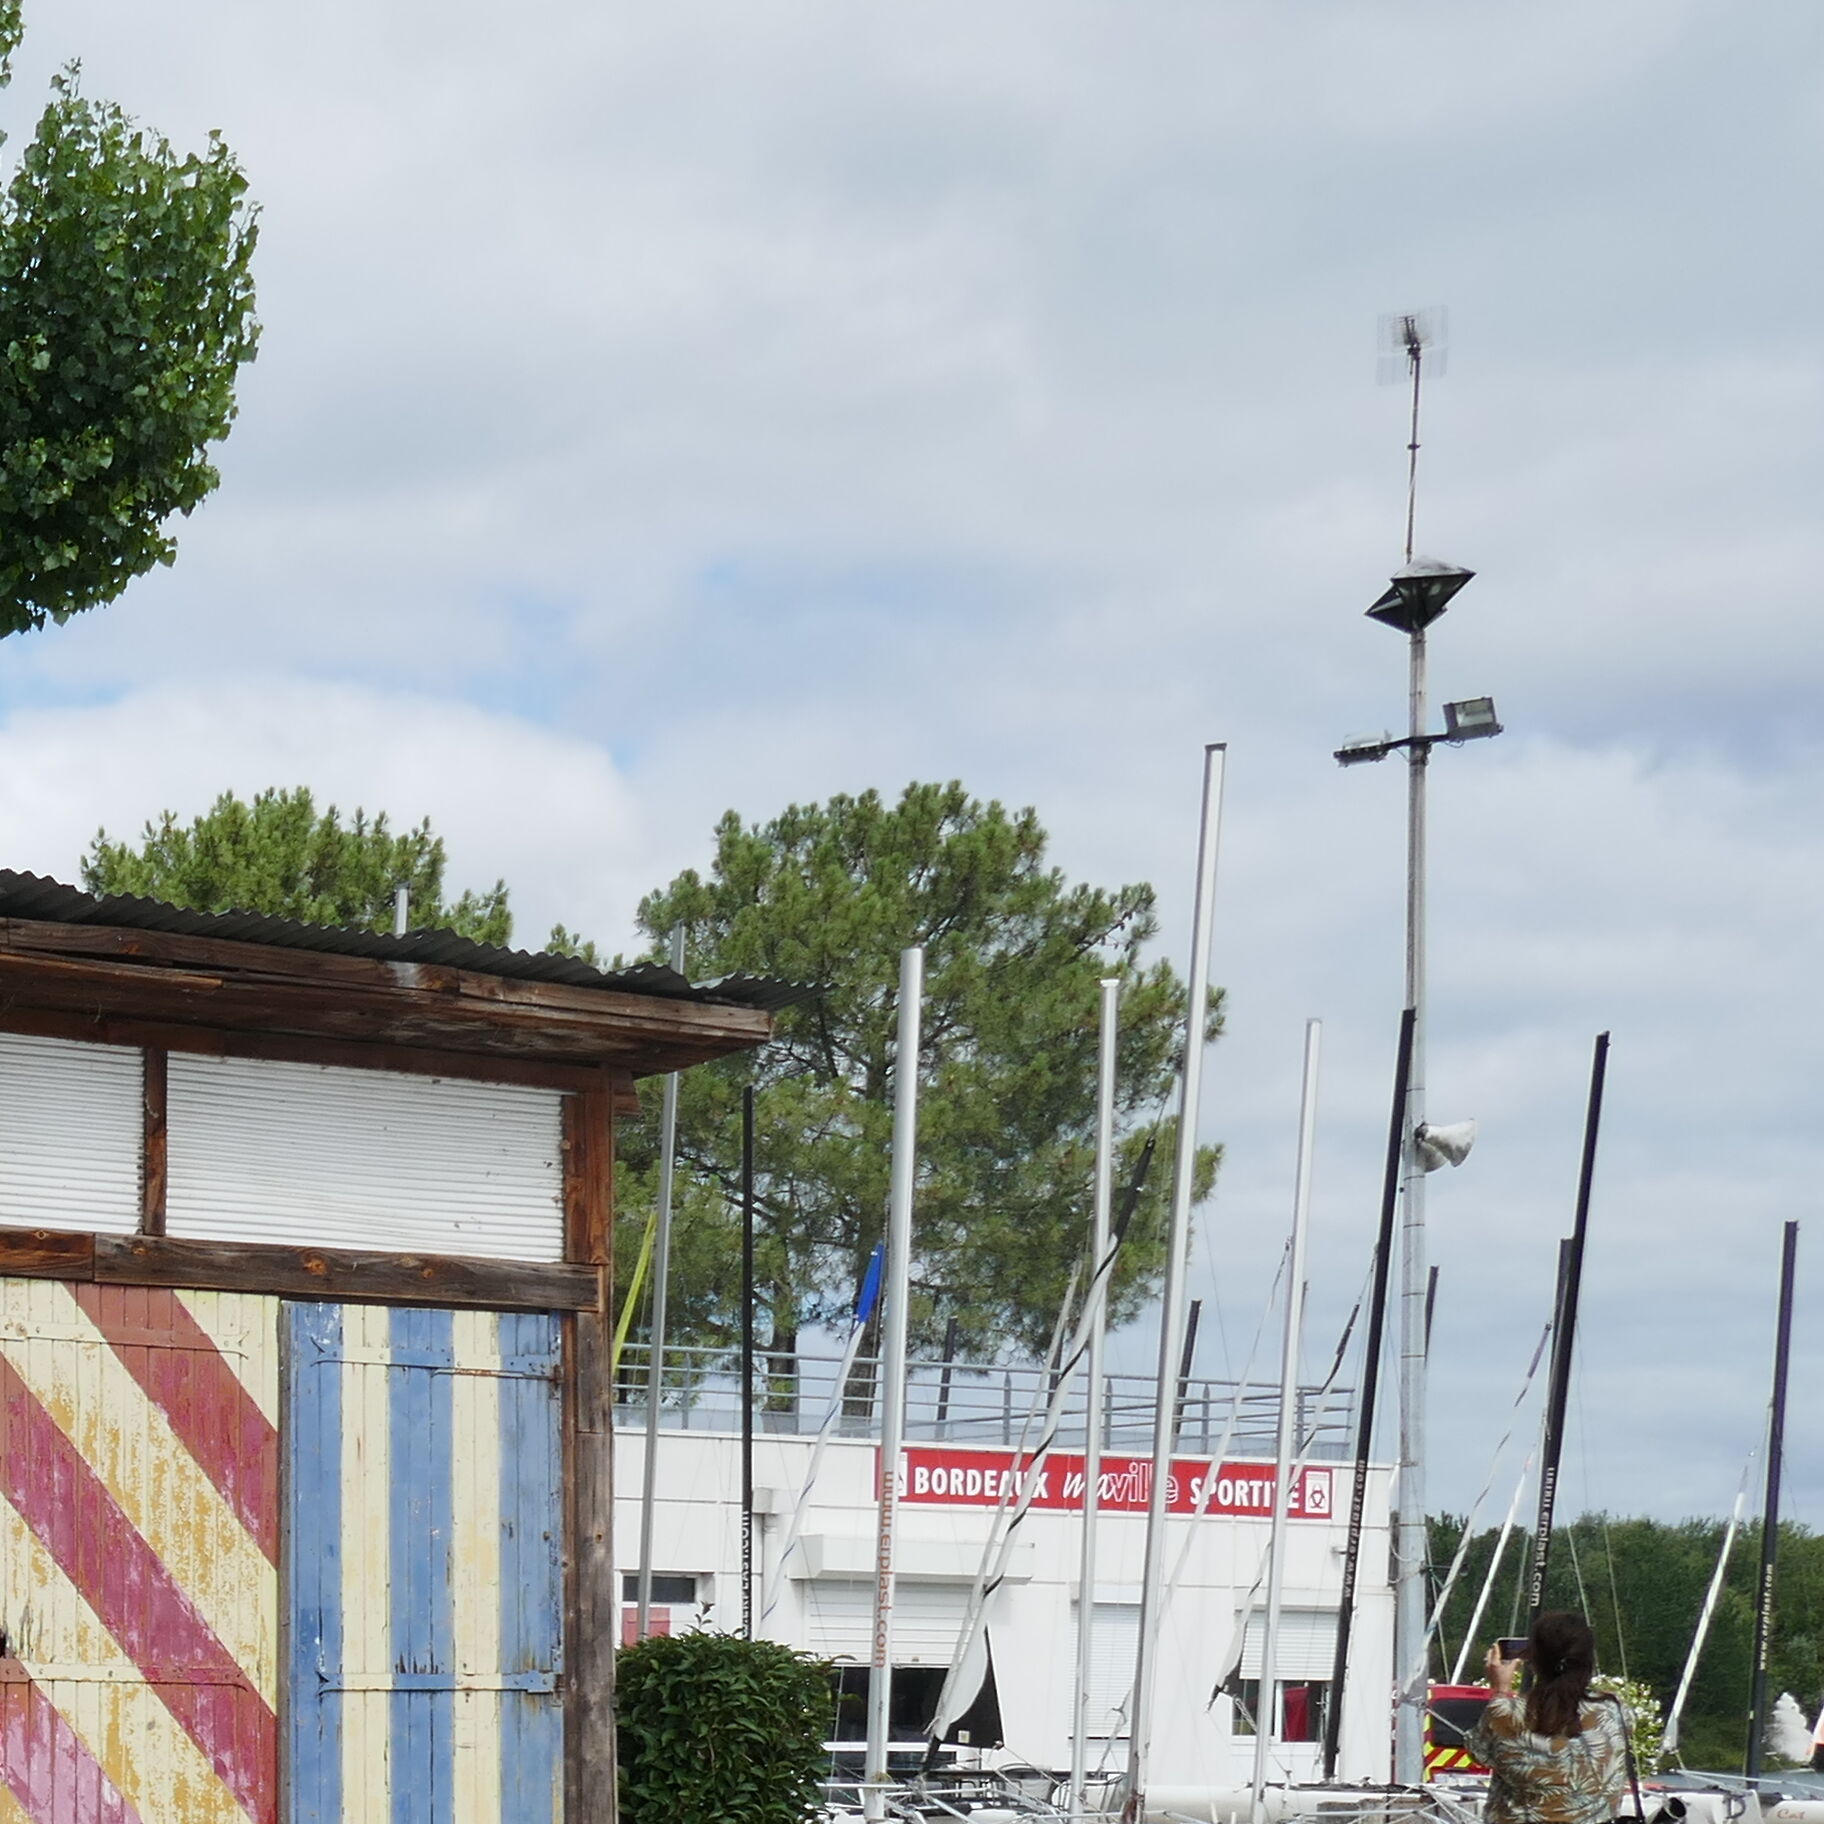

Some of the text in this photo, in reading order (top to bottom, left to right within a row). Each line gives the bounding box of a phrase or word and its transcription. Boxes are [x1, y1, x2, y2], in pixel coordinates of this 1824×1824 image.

[914, 1466, 1048, 1498] BORDEAUX
[1189, 1477, 1300, 1509] SPORTIE
[1343, 1459, 1366, 1598] www.erplast.com
[873, 1471, 894, 1669] www.erplast.com
